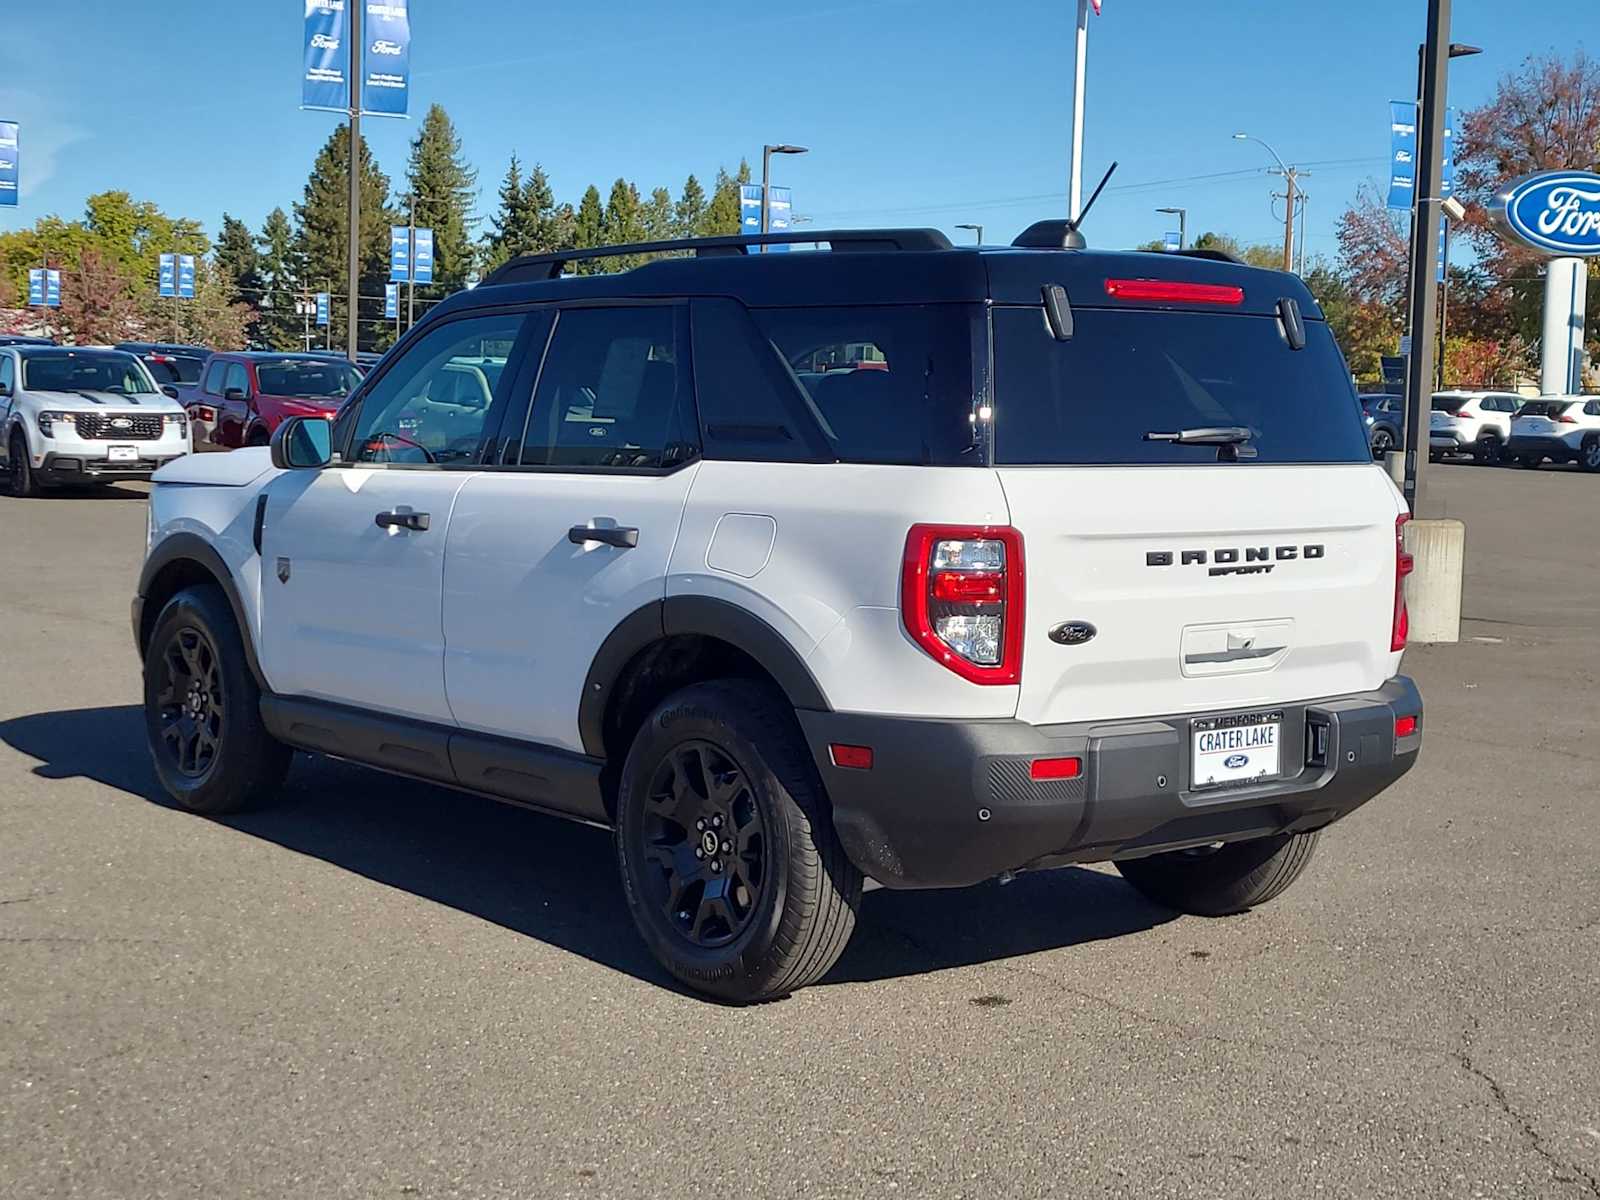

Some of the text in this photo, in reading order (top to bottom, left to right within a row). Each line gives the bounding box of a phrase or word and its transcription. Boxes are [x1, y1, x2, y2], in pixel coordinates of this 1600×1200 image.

[311, 34, 339, 49] Ford
[371, 40, 402, 55] Ford
[1539, 187, 1600, 236] For
[1146, 544, 1324, 566] BRONCO
[1208, 564, 1275, 577] SPORT
[1061, 626, 1088, 640] Ford
[1214, 714, 1263, 728] MEDFORD
[1199, 725, 1274, 752] CRATER LAKE
